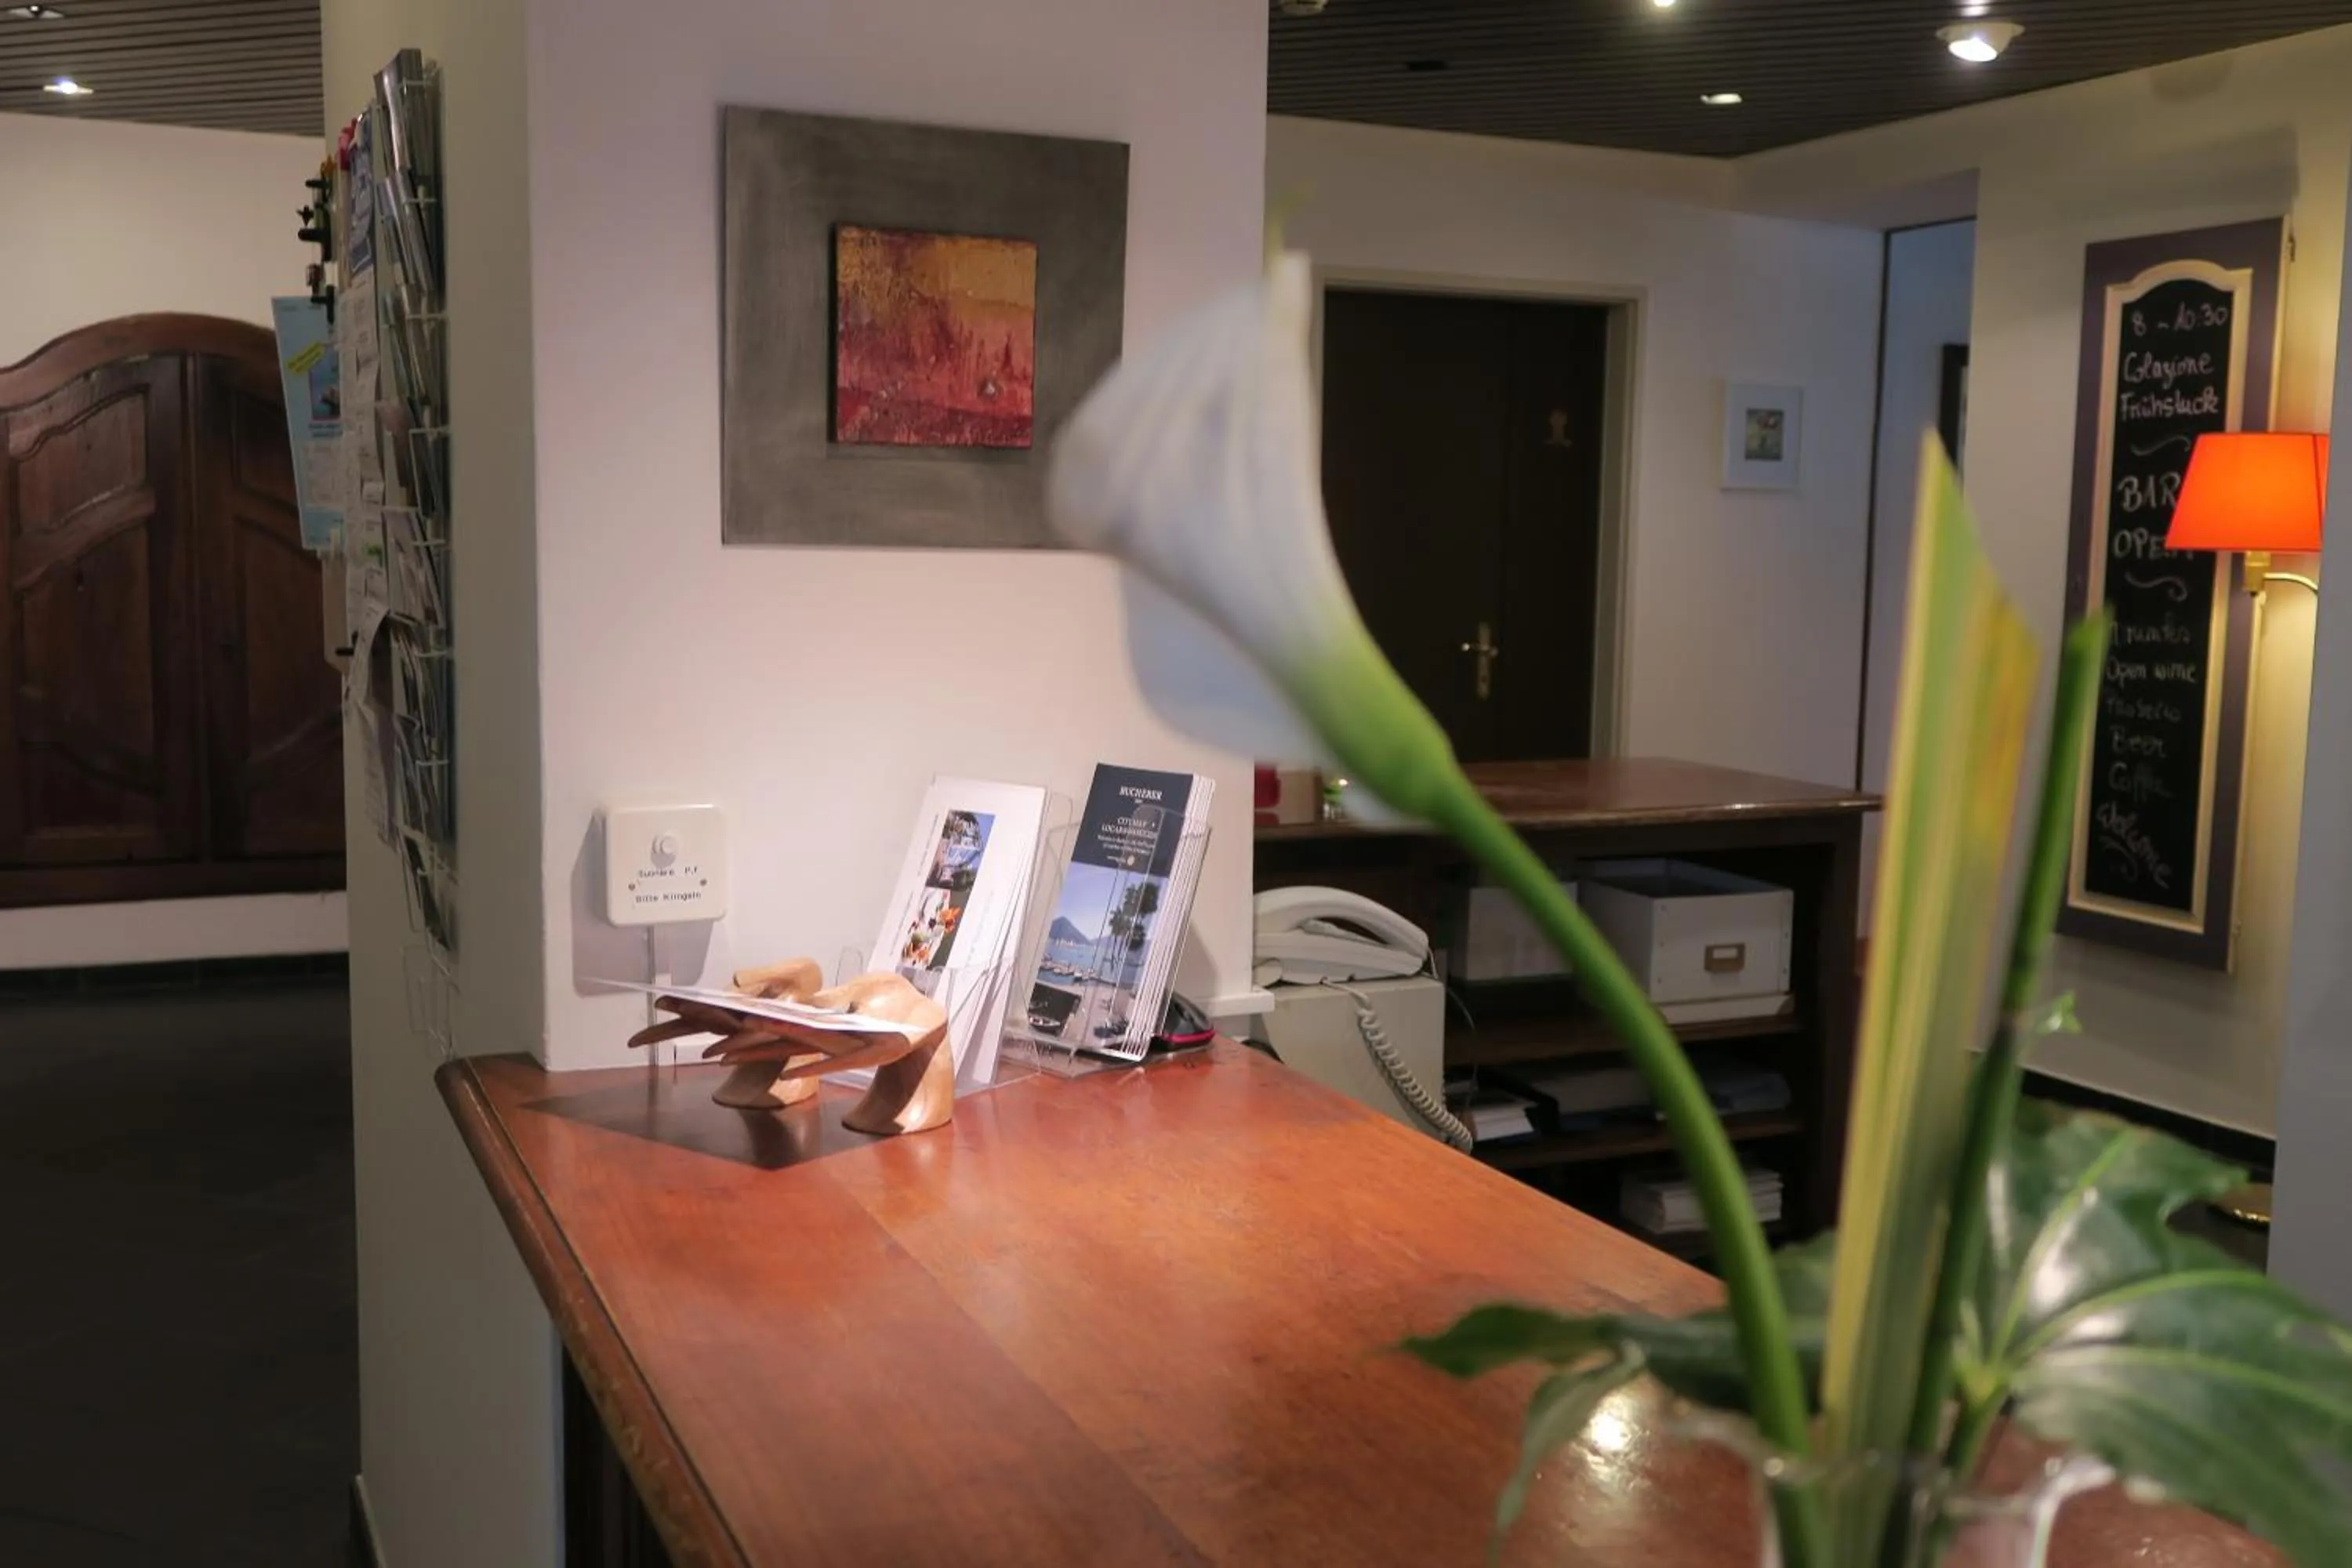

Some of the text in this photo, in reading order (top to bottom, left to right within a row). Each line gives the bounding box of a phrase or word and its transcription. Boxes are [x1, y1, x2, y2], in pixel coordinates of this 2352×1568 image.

[2132, 310, 2147, 337] 8
[2123, 351, 2215, 390] Colazione
[2118, 471, 2181, 511] BAR
[2113, 528, 2194, 561] OPE
